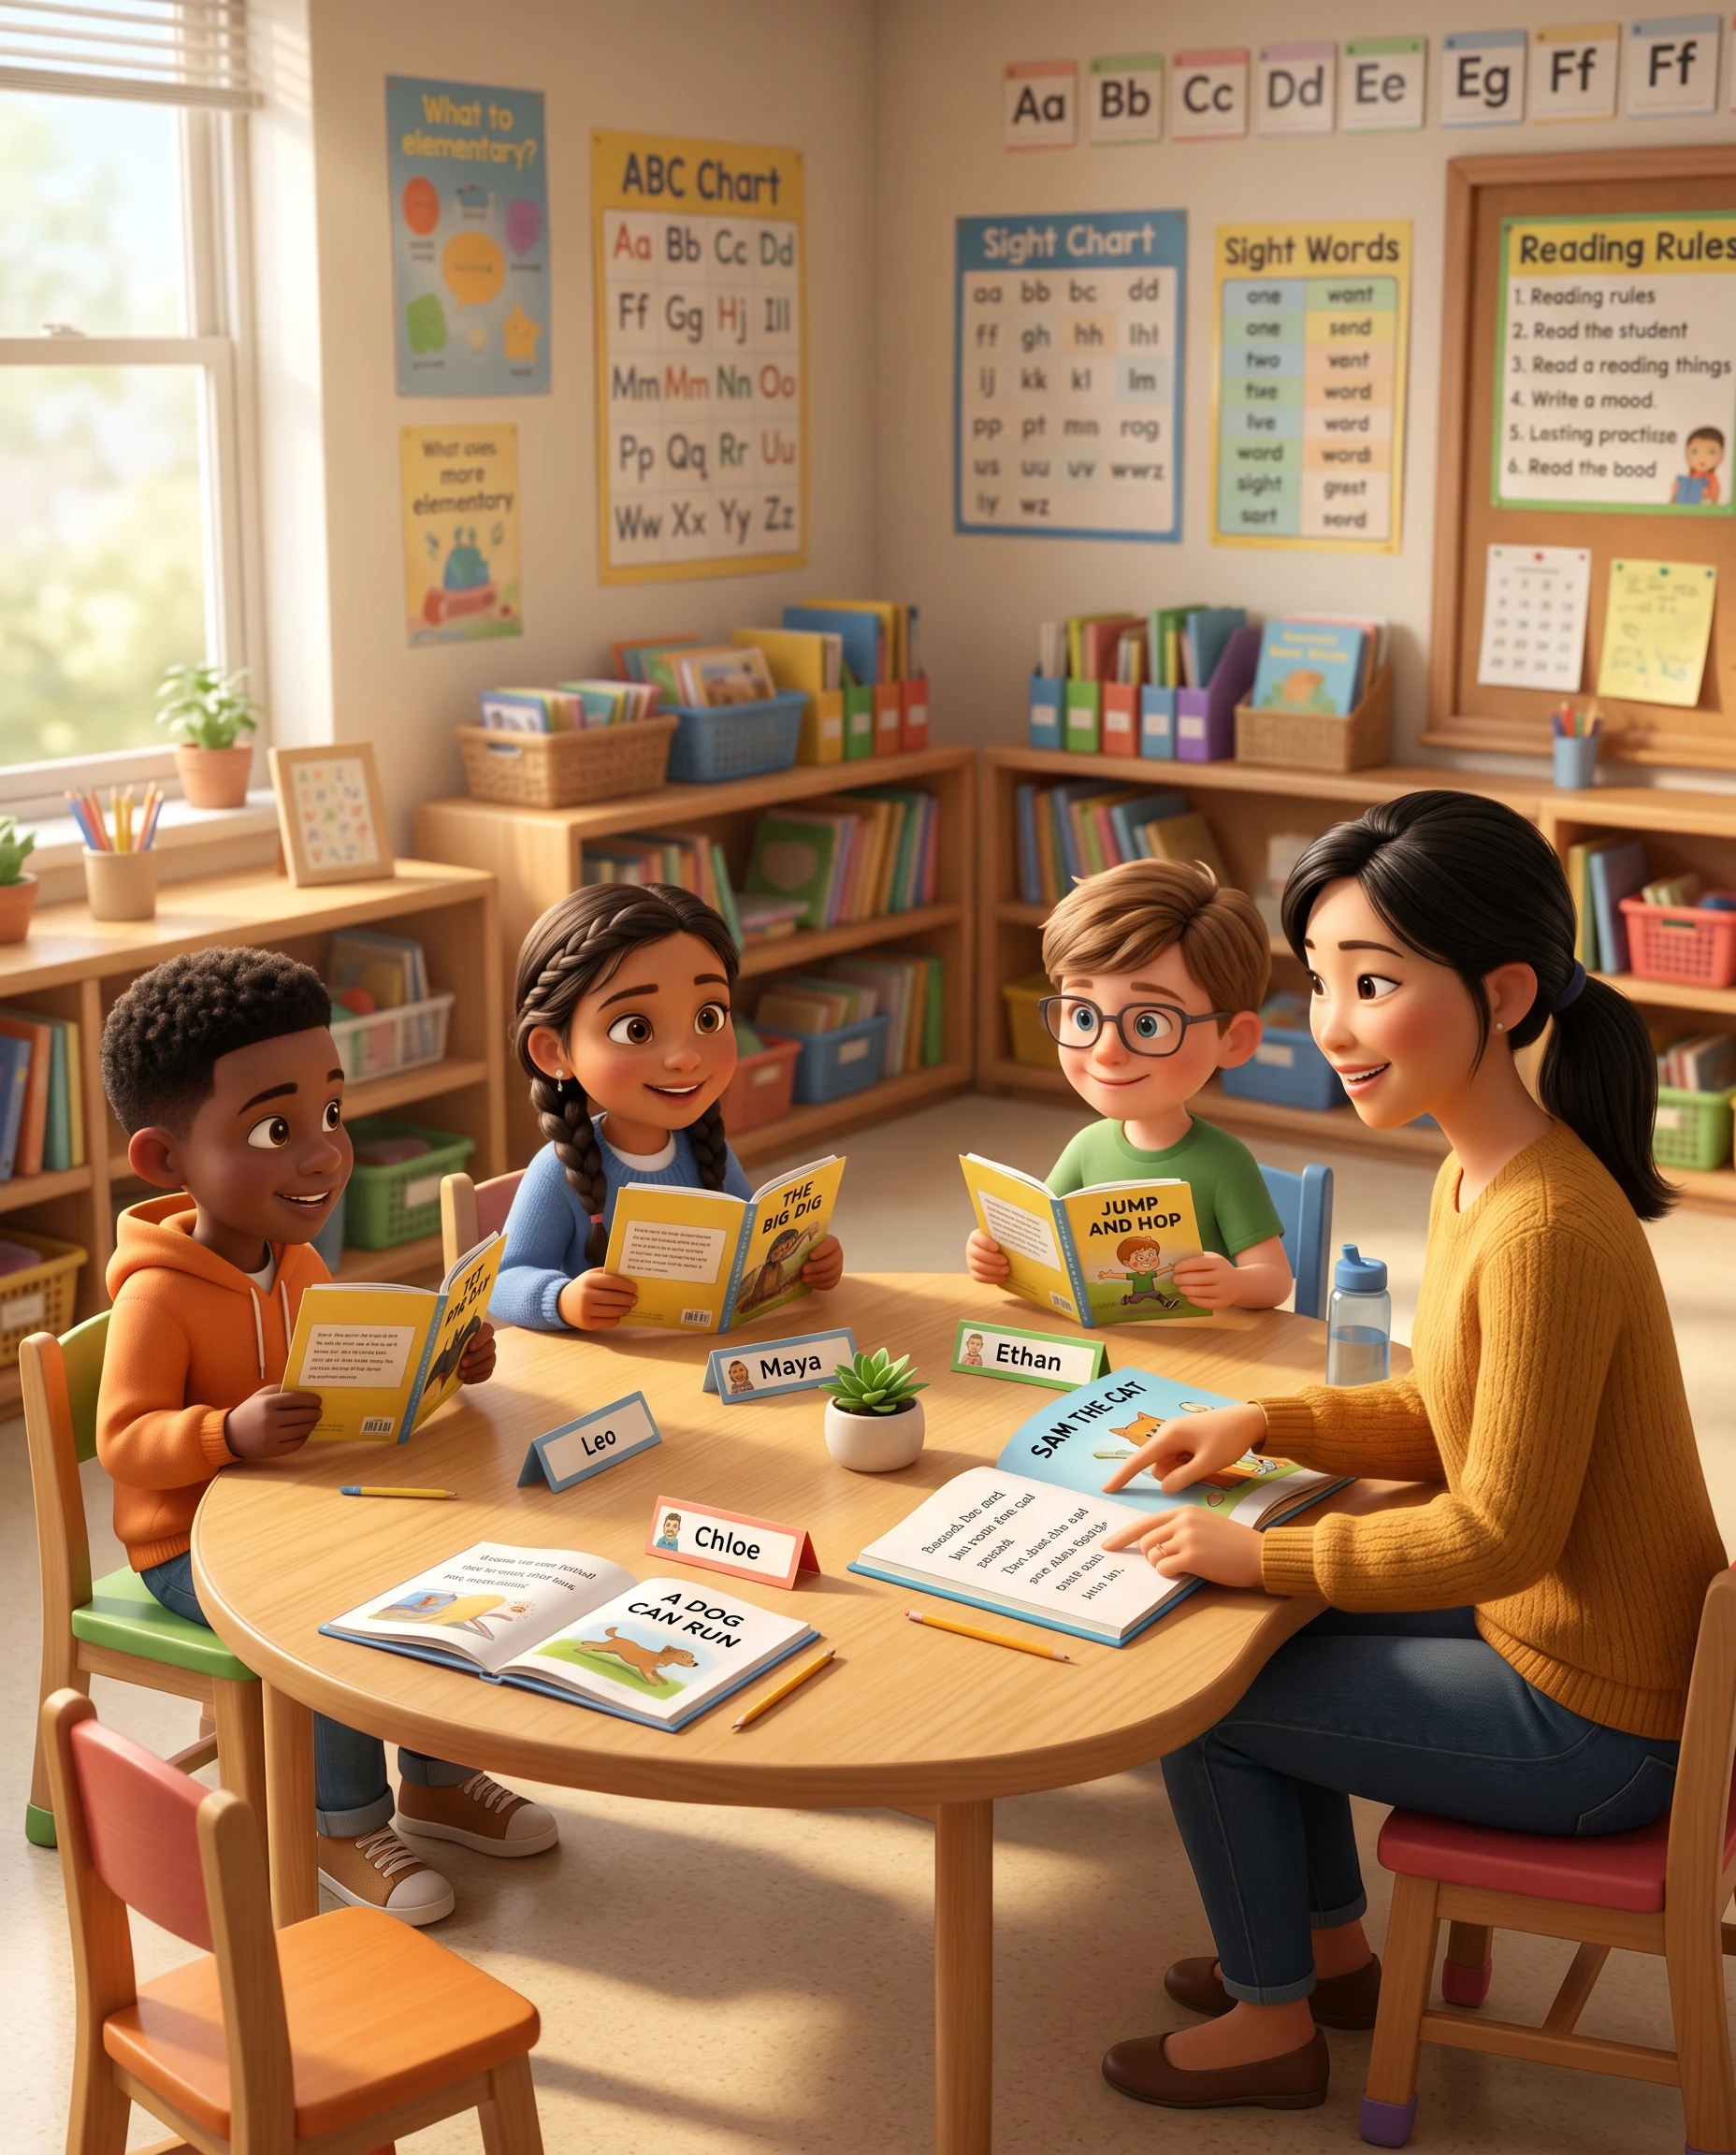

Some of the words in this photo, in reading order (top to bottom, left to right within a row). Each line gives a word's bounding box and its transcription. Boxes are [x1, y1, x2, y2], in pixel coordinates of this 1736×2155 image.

[1456, 56, 1511, 108] Eg
[1551, 48, 1597, 93] Ff
[1648, 41, 1698, 88] Ff
[1100, 79, 1150, 119] Bb
[1183, 76, 1234, 113] Cc
[1267, 65, 1324, 109] Dd
[1355, 63, 1407, 104] Ee
[421, 93, 482, 127] What
[488, 101, 514, 130] to
[1012, 86, 1066, 124] Aa
[401, 127, 538, 172] elementary?
[621, 152, 686, 198] ABC
[696, 160, 780, 207] Chart
[614, 224, 652, 262] Aa
[666, 225, 701, 263] Bb
[714, 229, 747, 266] Cc
[760, 231, 794, 268] Dd
[982, 226, 1058, 266] Sight
[1066, 224, 1156, 257] Chart
[1224, 236, 1295, 271] Sight
[1307, 233, 1400, 264] Words
[1519, 234, 1644, 268] Reading
[1656, 230, 1736, 262] Rules
[1246, 289, 1282, 306] one
[1326, 285, 1374, 304] want
[1530, 287, 1603, 309] Reading
[1610, 287, 1656, 305] rules
[618, 292, 649, 331] Ff
[665, 294, 703, 344] Gg
[716, 296, 746, 345] Hj
[1246, 320, 1280, 338] one
[1512, 322, 1528, 340] 2.
[1534, 322, 1579, 340] Read
[1584, 323, 1613, 340] the
[1619, 323, 1687, 340] student
[612, 365, 659, 401] Mm
[664, 364, 710, 401] Mm
[716, 365, 752, 399] Nn
[760, 364, 796, 400] Oo
[1511, 356, 1526, 373] 3.
[1532, 356, 1577, 374] Read
[1584, 359, 1594, 374] a
[1599, 356, 1669, 379] reading
[1675, 355, 1731, 379] things
[1511, 390, 1525, 407] 4.
[1531, 390, 1579, 408] Write
[1584, 394, 1596, 409] a
[1510, 424, 1524, 441] 5.
[619, 435, 654, 482] Pp
[719, 432, 748, 468] Rr
[760, 431, 795, 466] Uu
[1508, 457, 1523, 475] 6.
[1528, 458, 1573, 476] Read
[1579, 459, 1608, 476] the
[615, 505, 662, 542] Ww
[672, 501, 706, 539] Xx
[718, 499, 751, 545] Yy
[763, 496, 795, 533] Zz
[783, 1180, 814, 1208] THE
[1101, 1196, 1159, 1216] JUMP
[762, 1209, 789, 1235] BIG
[794, 1195, 822, 1220] DIG
[1089, 1219, 1133, 1237] AND
[1138, 1212, 1181, 1231] HOP
[760, 1355, 822, 1380] Maya
[995, 1343, 1062, 1372] Ethan
[1031, 1422, 1078, 1459] SAM
[1067, 1400, 1114, 1424] THE
[1104, 1381, 1148, 1403] CAT
[581, 1429, 616, 1456] Leo
[694, 1526, 760, 1560] Chloe
[628, 1602, 684, 1625] CAN
[682, 1621, 742, 1648] RUN
[660, 1593, 682, 1605] A
[684, 1600, 745, 1627] DOG
